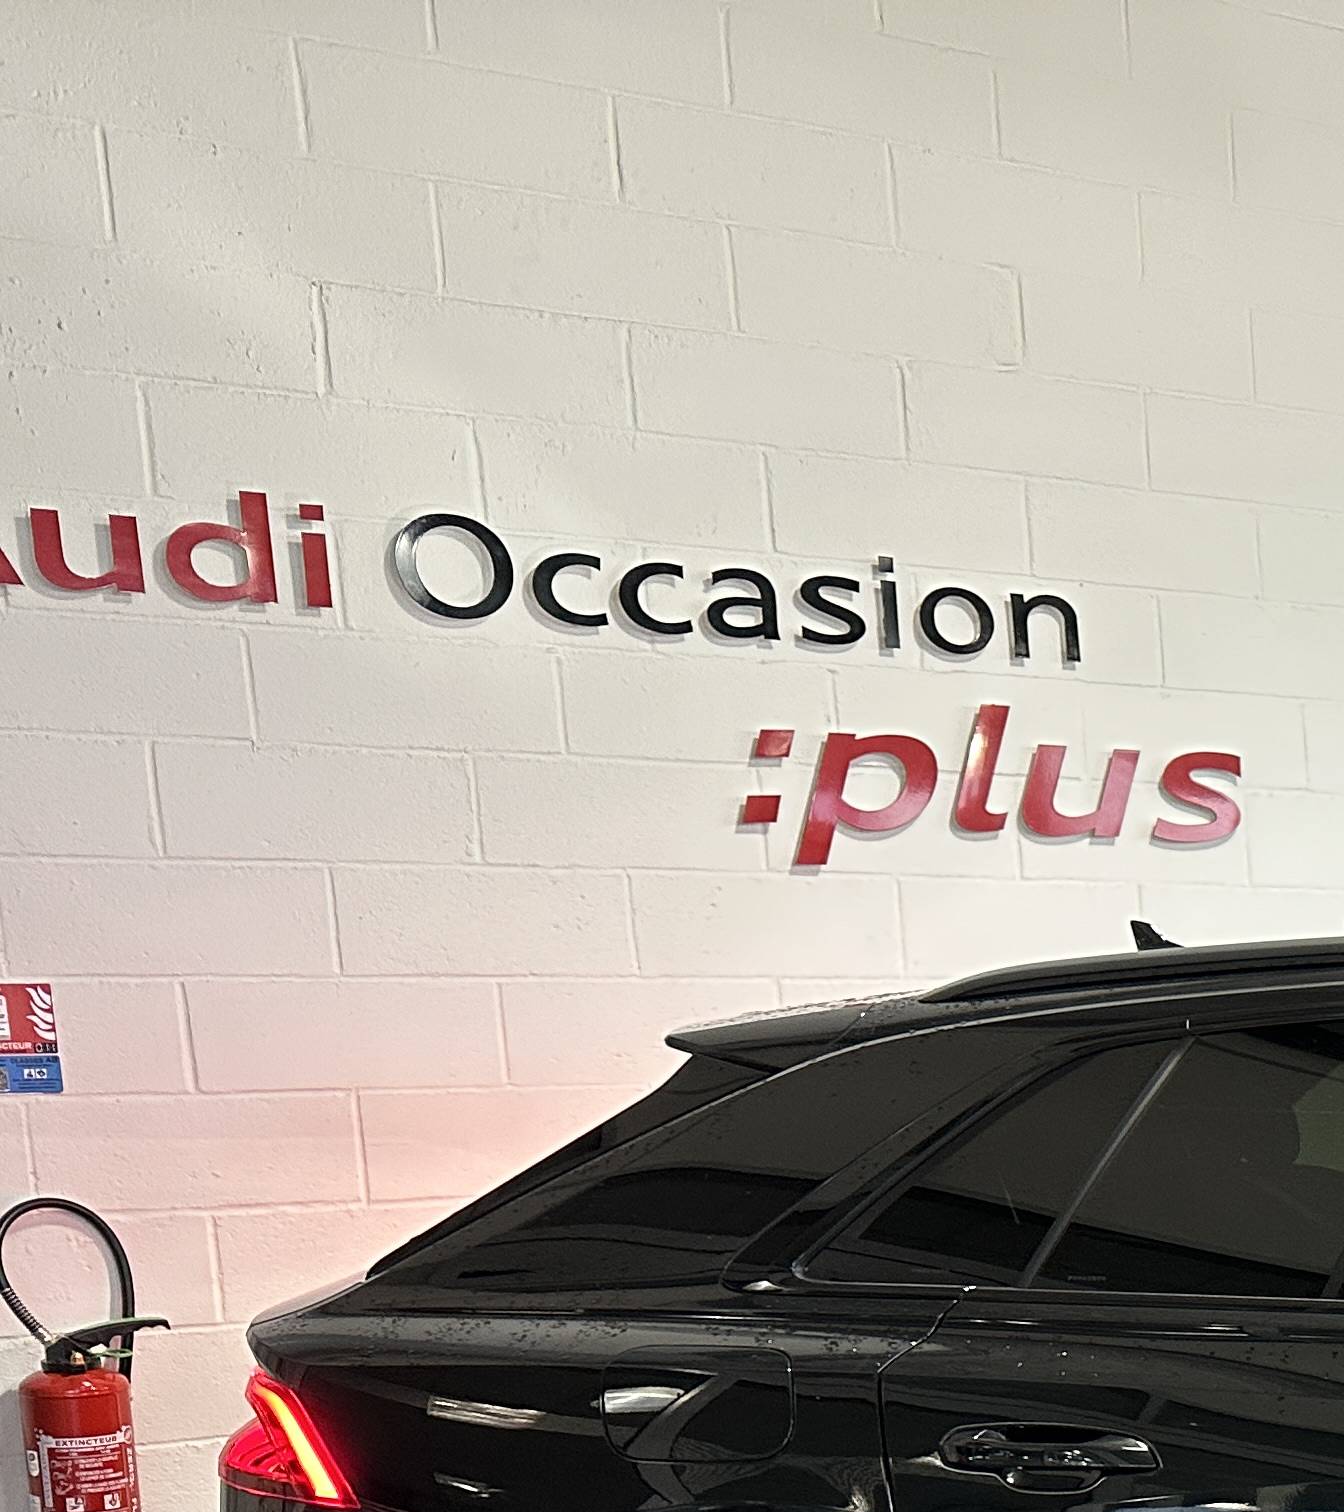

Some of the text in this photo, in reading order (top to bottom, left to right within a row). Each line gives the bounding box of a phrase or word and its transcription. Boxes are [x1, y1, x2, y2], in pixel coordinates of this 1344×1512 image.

[394, 512, 1081, 663] Occasion
[742, 703, 1242, 866] :plus
[55, 1435, 117, 1447] EXTINCTEUR
